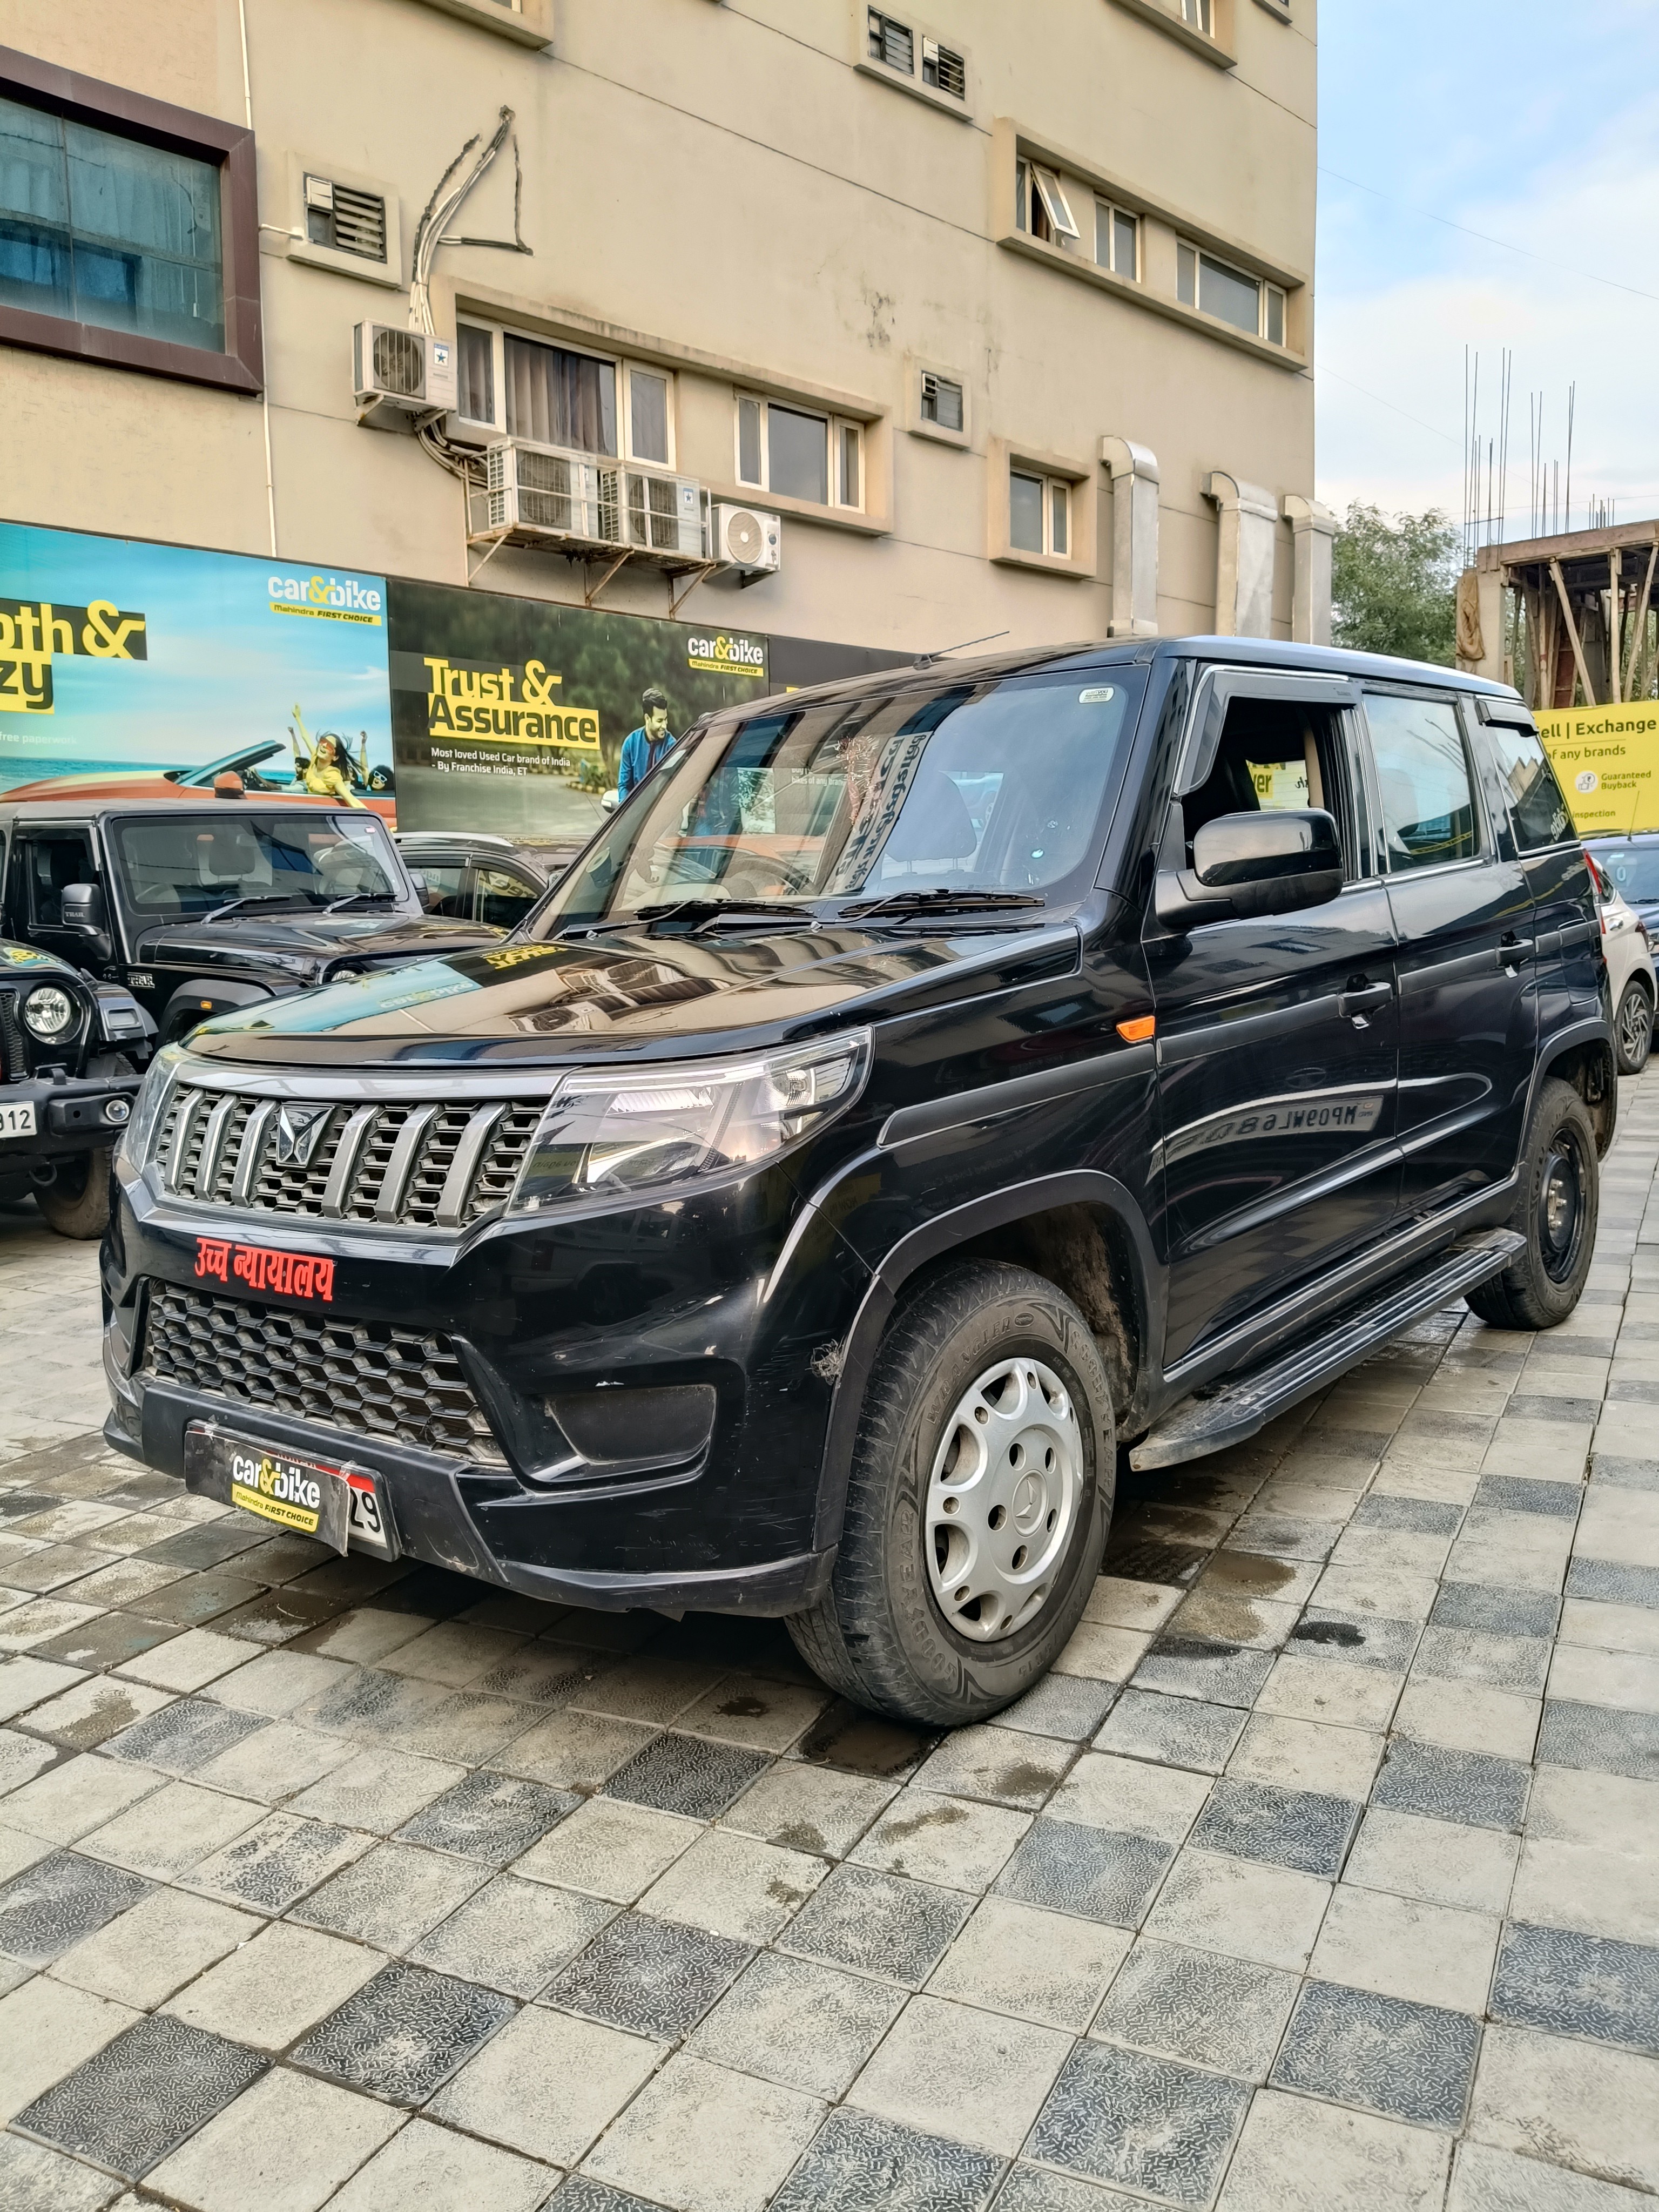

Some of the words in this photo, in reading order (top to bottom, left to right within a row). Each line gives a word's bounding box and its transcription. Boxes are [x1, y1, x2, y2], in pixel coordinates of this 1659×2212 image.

[268, 576, 381, 611] car&bike
[274, 604, 314, 616] Mahindra
[317, 611, 342, 619] FIRST
[343, 613, 373, 623] CHOICE
[83, 599, 146, 659] &
[688, 636, 764, 665] car&bike
[692, 660, 719, 669] Mahindra
[424, 657, 514, 701] Trust
[522, 660, 562, 706] &
[428, 694, 597, 743] Assurance
[1537, 723, 1561, 738] ell
[1576, 719, 1657, 736] Exchange
[22, 735, 77, 745] paperwork
[431, 747, 453, 758] Most
[454, 749, 477, 760] loved
[479, 751, 500, 762] Used
[502, 753, 515, 763] Car
[517, 754, 540, 765] brand
[542, 756, 551, 766] of
[551, 758, 571, 767] India
[1560, 750, 1581, 761] any
[1584, 745, 1626, 757] brands
[437, 761, 449, 773] By
[451, 762, 491, 774] Franchise
[493, 765, 516, 776] India,
[517, 767, 528, 776] ET
[1601, 770, 1651, 781] Guaranteed
[808, 777, 815, 785] of
[816, 778, 827, 787] any
[1601, 780, 1637, 791] Buyback
[1572, 810, 1616, 819] inspection
[195, 1237, 232, 1282] उच्च
[234, 1244, 334, 1301] न्यायालय
[926, 1316, 1011, 1425] WRANGLER
[1069, 1330, 1116, 1491] GOODYEAR
[233, 1455, 320, 1509] car&bike
[236, 1491, 264, 1509] Mahindra
[265, 1503, 286, 1517] FIRST
[286, 1510, 314, 1526] CHOICE
